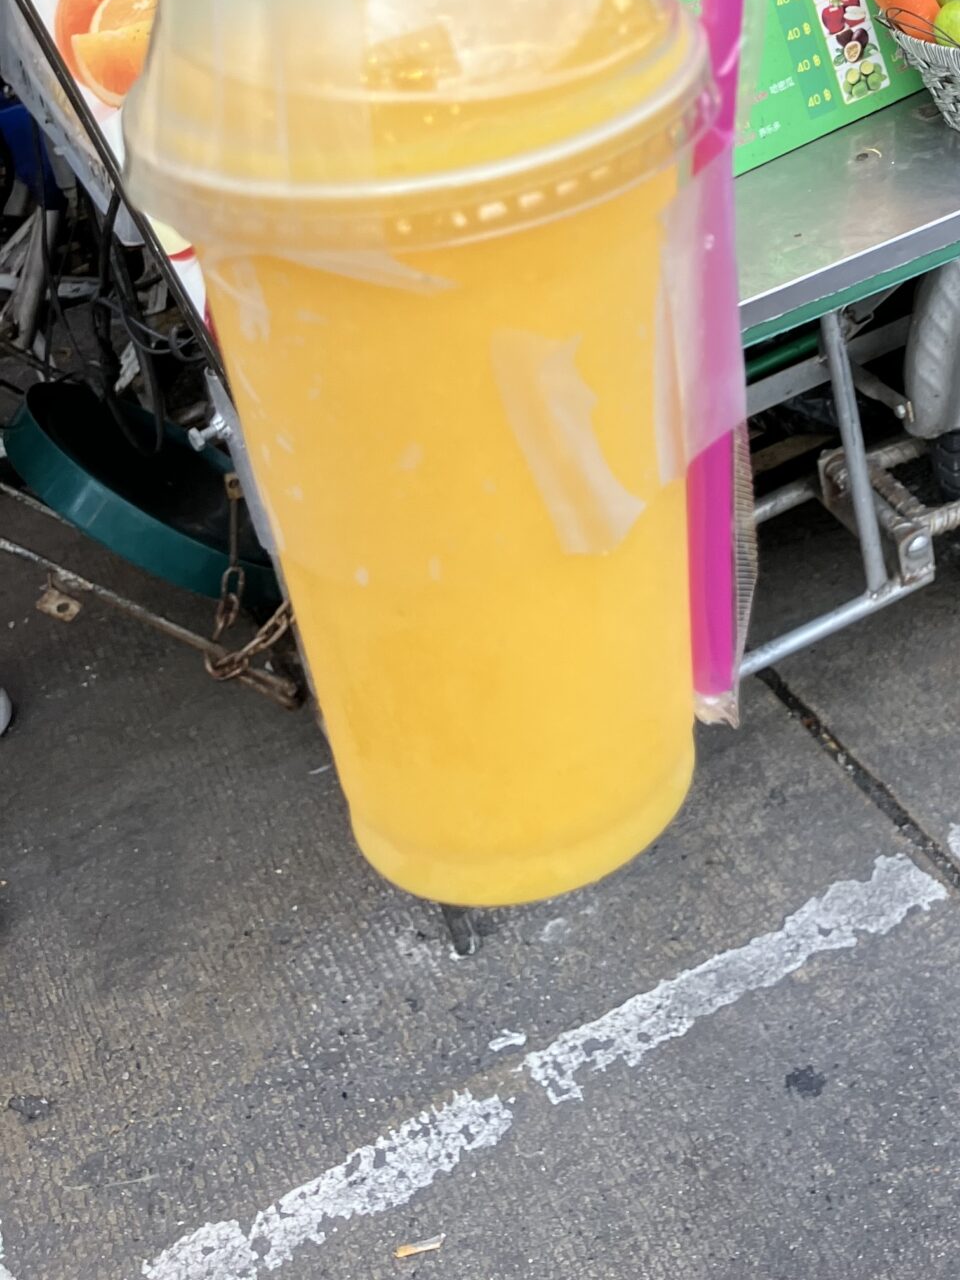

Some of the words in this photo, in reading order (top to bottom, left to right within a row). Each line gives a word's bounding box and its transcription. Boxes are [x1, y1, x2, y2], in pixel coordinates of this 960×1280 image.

[787, 27, 800, 40] 40
[797, 60, 810, 73] 40
[808, 94, 821, 107] 40
